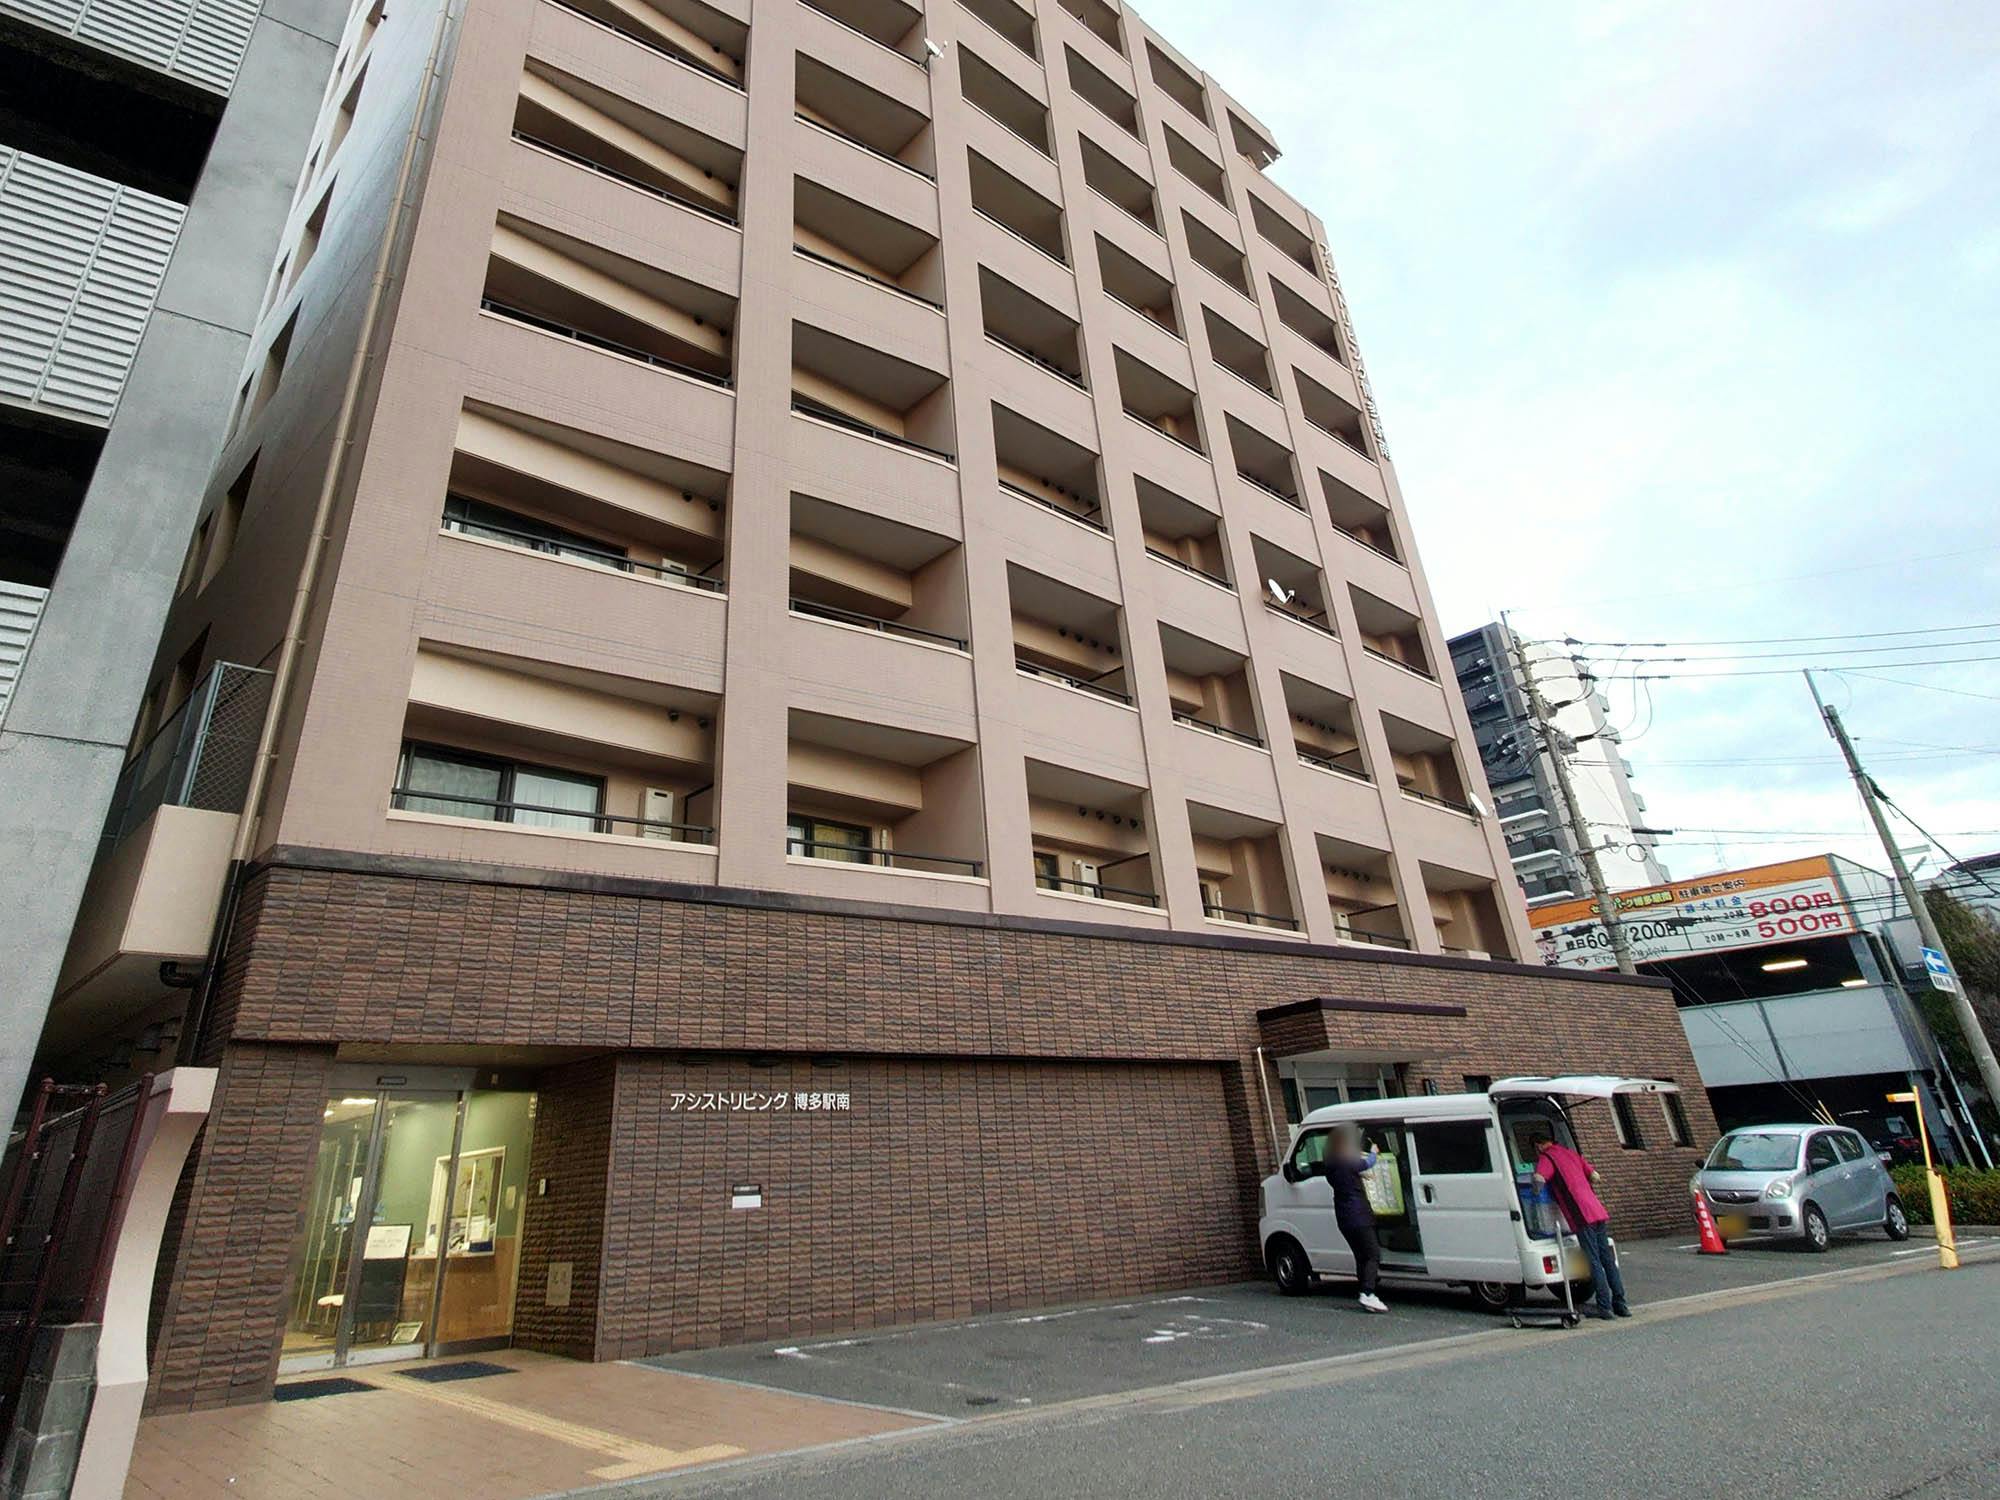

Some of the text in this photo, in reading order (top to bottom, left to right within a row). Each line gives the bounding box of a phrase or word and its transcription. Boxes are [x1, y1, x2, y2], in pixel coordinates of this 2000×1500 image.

[1748, 892, 1834, 919] 800円
[1757, 911, 1843, 939] 500円
[670, 1092, 850, 1111] アシストリビング 博多駅南
